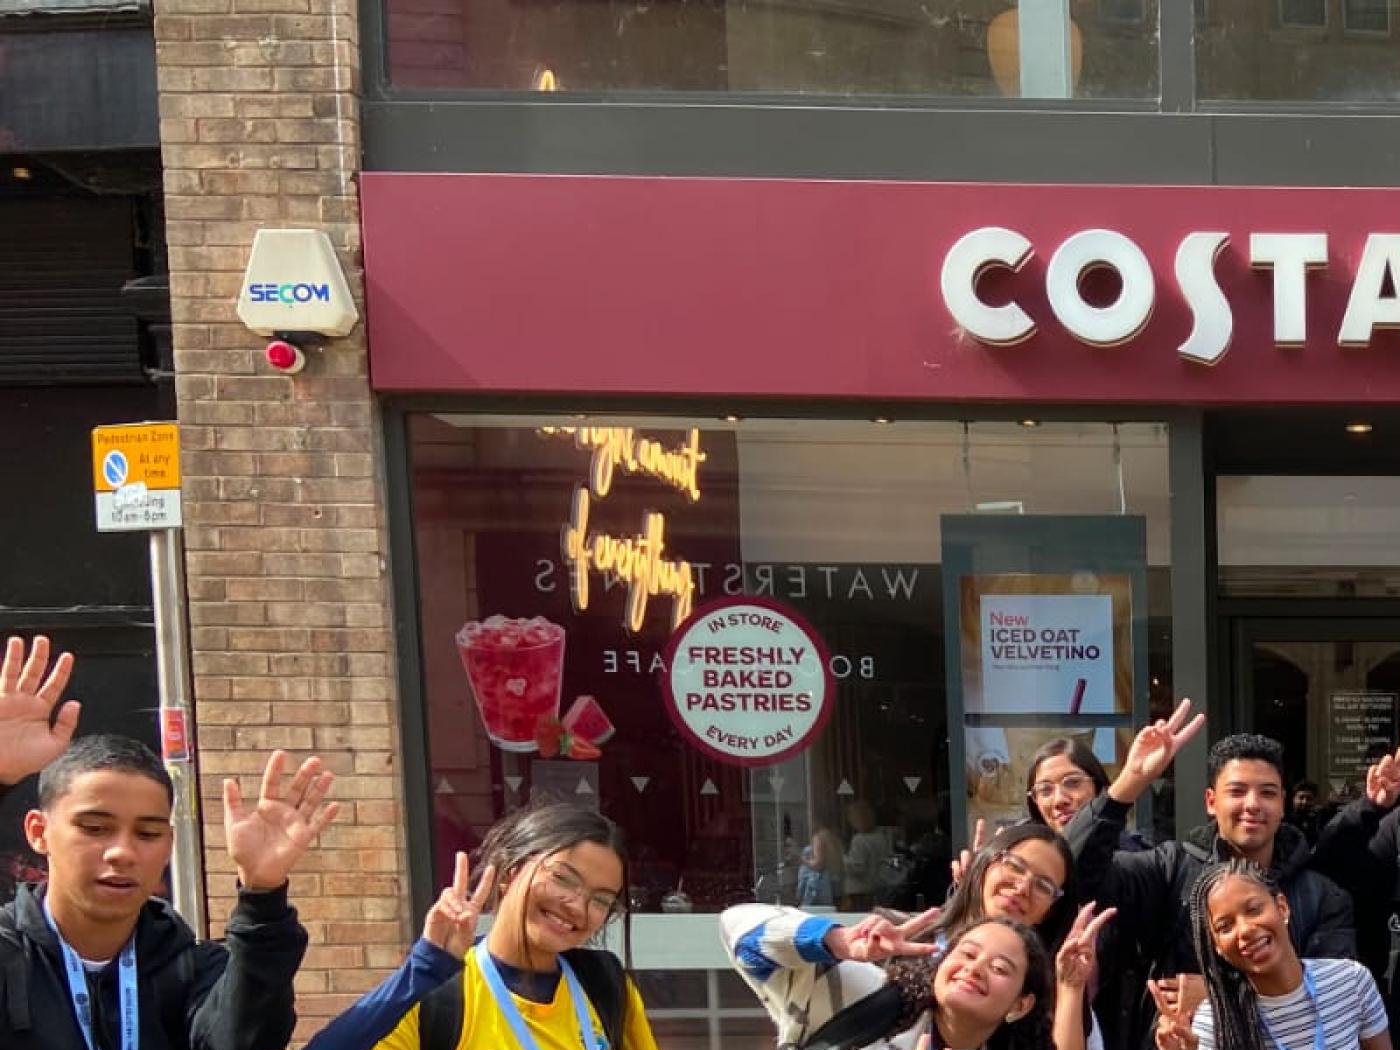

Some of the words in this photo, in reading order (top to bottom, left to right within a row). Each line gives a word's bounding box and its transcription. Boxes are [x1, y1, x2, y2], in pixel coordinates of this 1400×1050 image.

[249, 283, 329, 303] SECOM
[707, 617, 726, 633] IN
[727, 613, 785, 633] STORE
[990, 611, 1030, 626] New
[990, 629, 1037, 643] ICED
[1040, 629, 1081, 643] OAT
[688, 647, 806, 666] FRESHLY
[990, 645, 1101, 660] VELVETINO
[702, 670, 792, 689] BAKED
[686, 692, 813, 712] PASTRIES
[706, 725, 759, 750] EVERY
[764, 724, 794, 748] DAY
